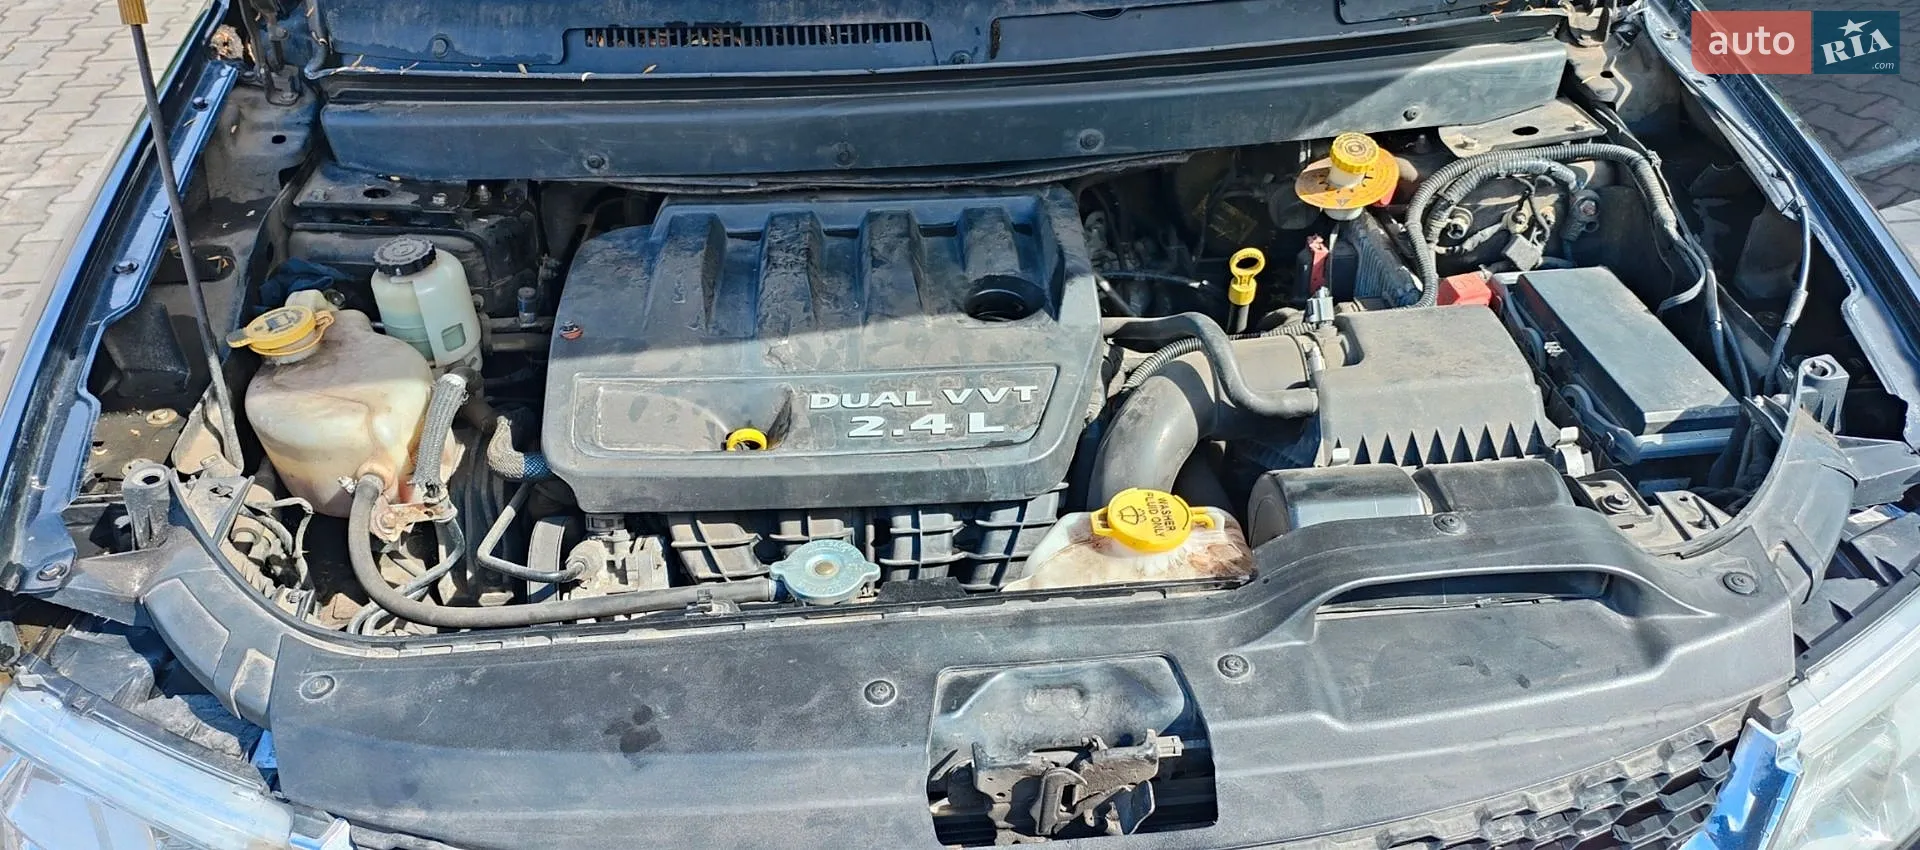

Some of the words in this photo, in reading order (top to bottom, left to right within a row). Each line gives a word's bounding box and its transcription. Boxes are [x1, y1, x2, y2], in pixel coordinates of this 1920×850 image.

[809, 390, 932, 409] DUAL
[942, 385, 1038, 404] VVT
[848, 412, 953, 438] 2.4
[967, 411, 1005, 434] L
[1145, 492, 1158, 515] FLUID
[1158, 497, 1177, 531] WASHER
[1151, 516, 1166, 538] ONLY
